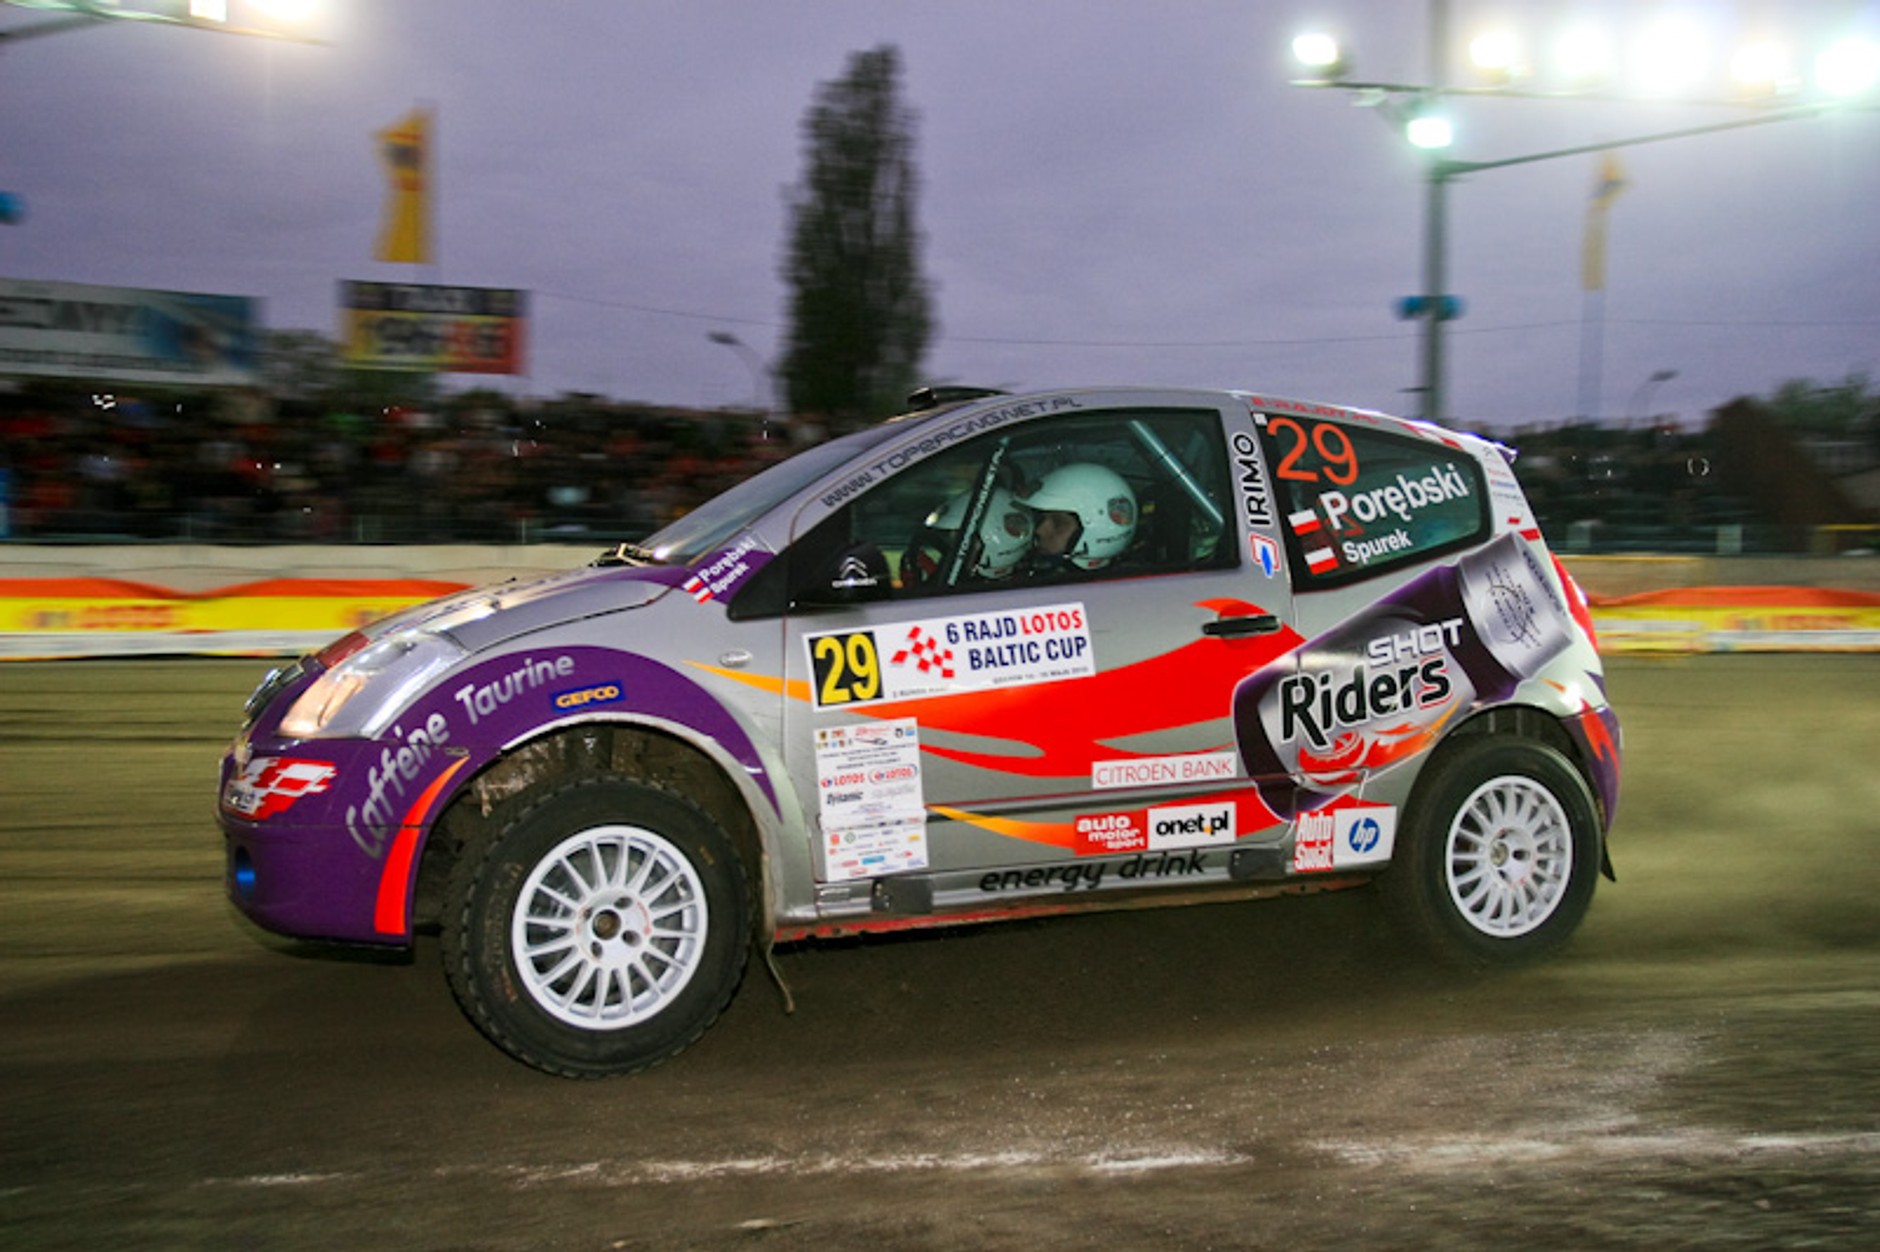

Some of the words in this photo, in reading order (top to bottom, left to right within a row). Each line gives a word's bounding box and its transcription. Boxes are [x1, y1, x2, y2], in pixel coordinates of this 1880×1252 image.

[1267, 417, 1359, 486] 29
[1231, 432, 1273, 527] IRIMO
[1318, 463, 1470, 530] Porębski
[1342, 528, 1413, 565] Spurek
[946, 622, 960, 645] 6
[963, 616, 1017, 642] RAJD
[1020, 609, 1084, 636] LOTOS
[1367, 617, 1463, 669] SHOT
[815, 633, 879, 705] 29
[968, 641, 1041, 671] BALTIC
[1045, 636, 1088, 662] CUP
[455, 656, 575, 726] Taurine
[556, 685, 620, 708] GEFCO
[1279, 655, 1453, 749] Riders
[1182, 758, 1233, 779] BANK
[1077, 814, 1131, 833] auto
[1088, 828, 1141, 843] motor
[1155, 810, 1229, 836] onet.pl
[1350, 817, 1378, 853] hp
[979, 861, 1107, 892] energy
[1118, 849, 1208, 880] drink
